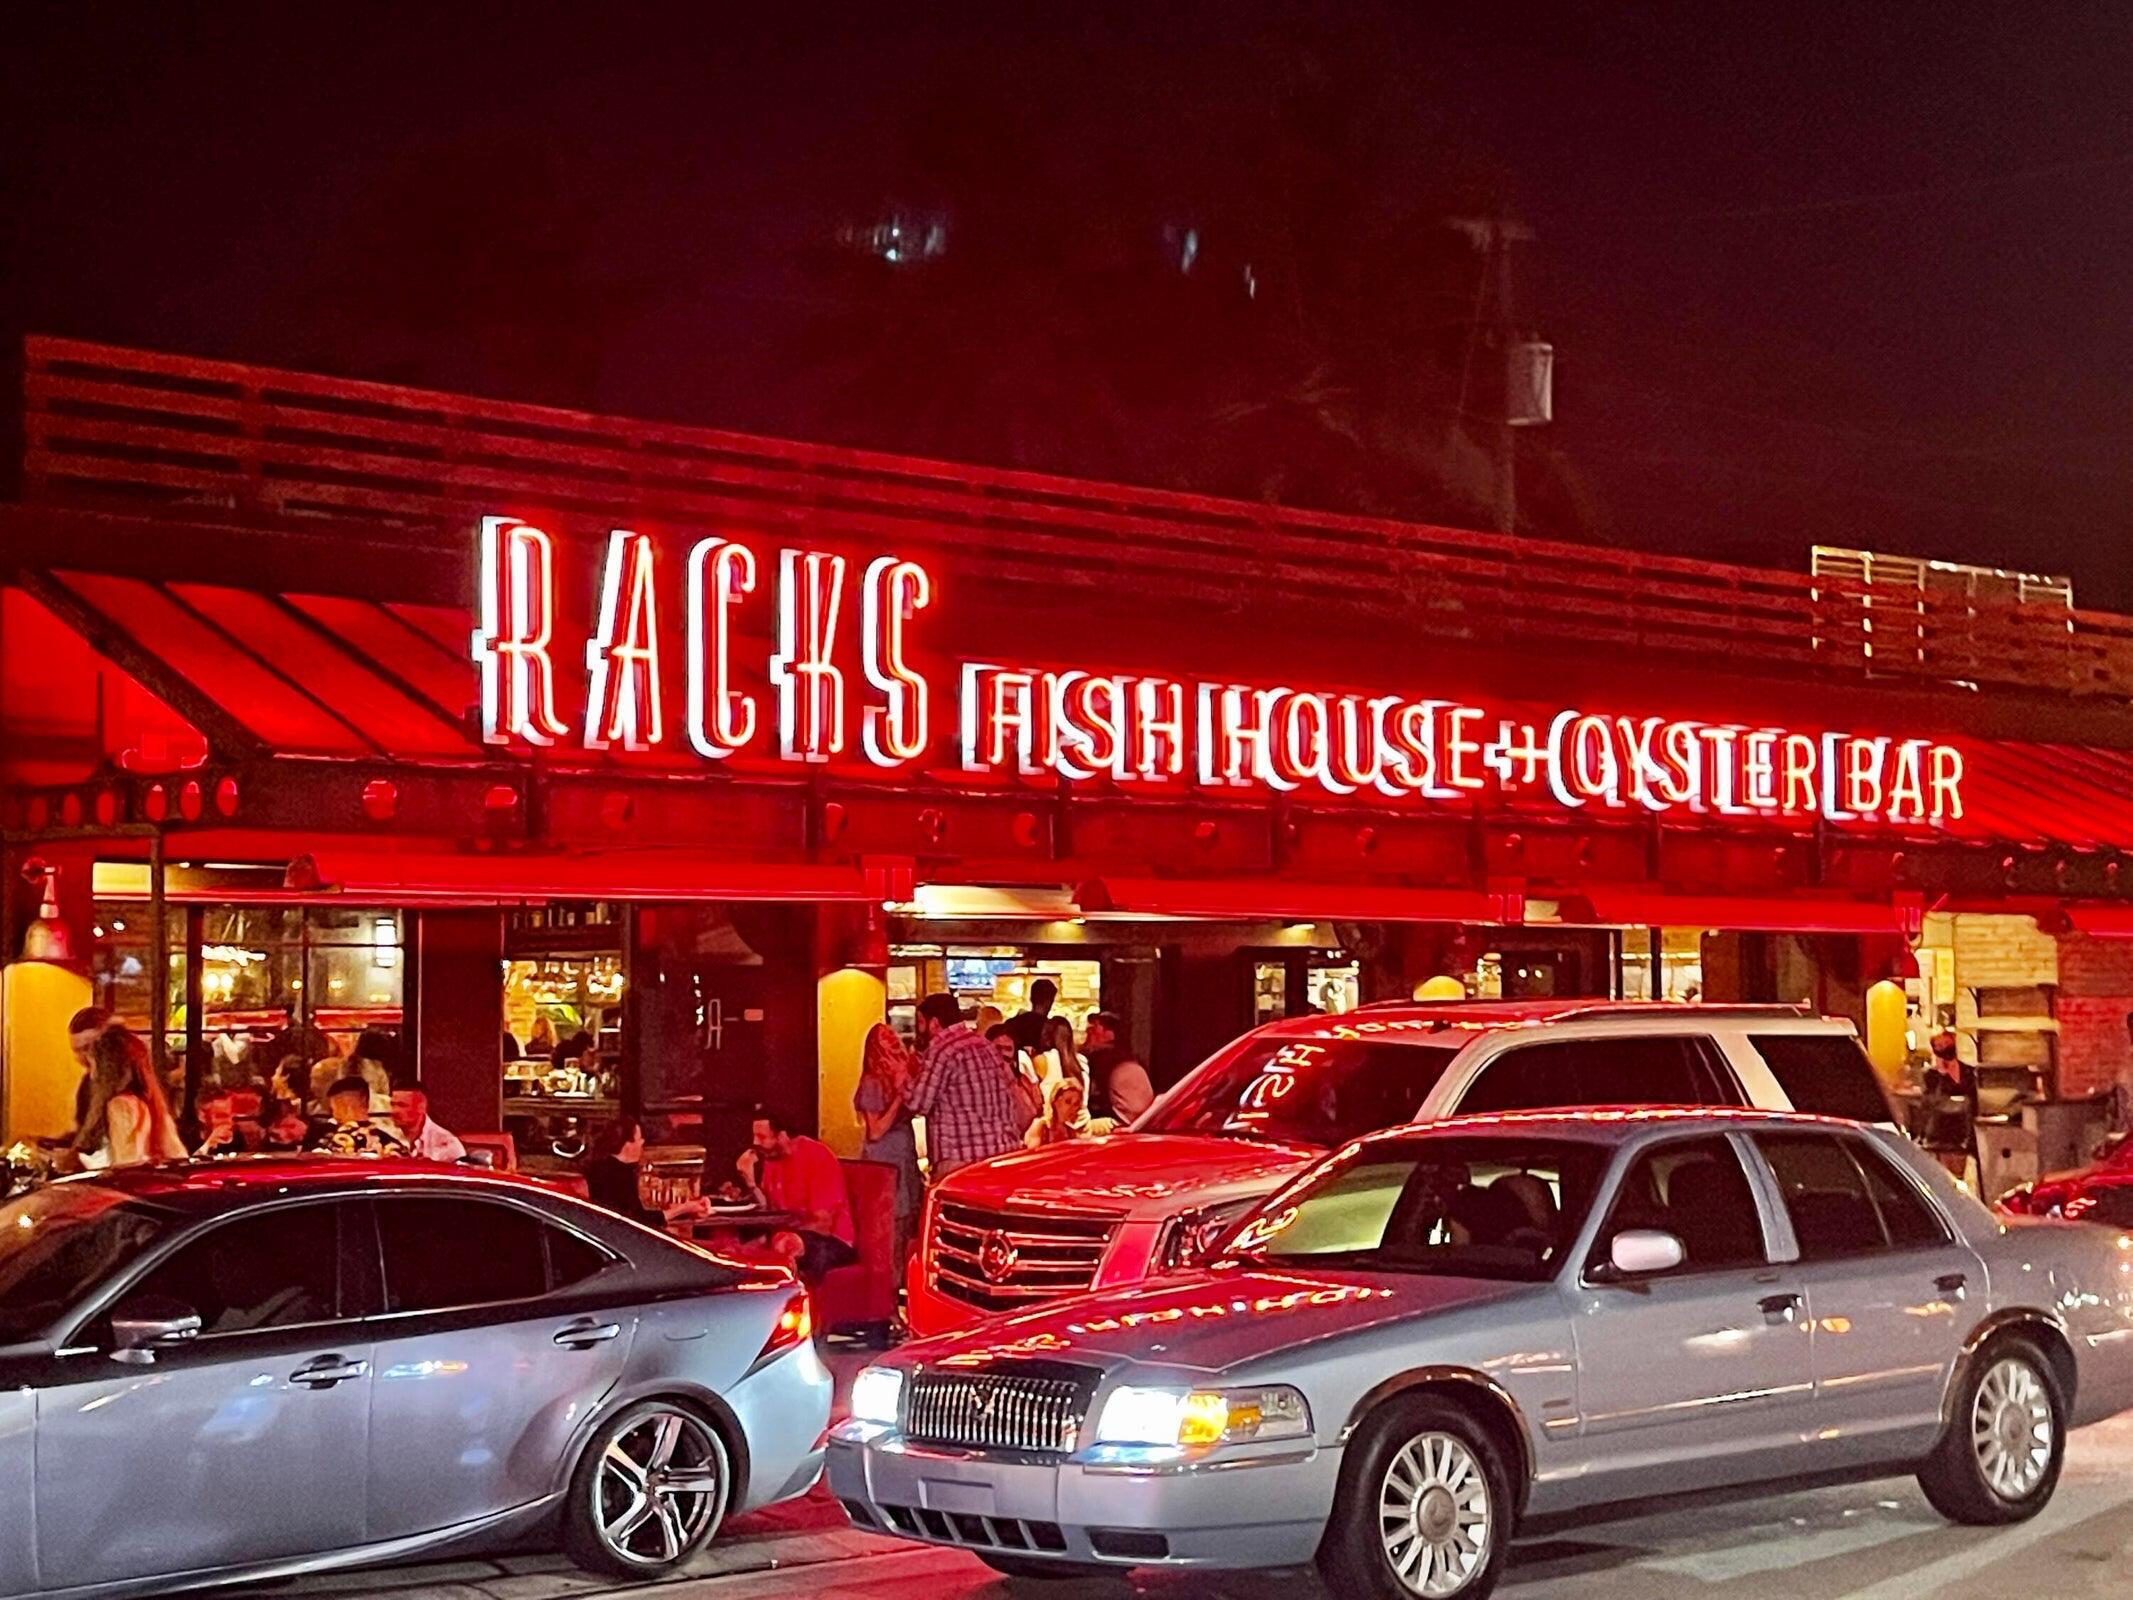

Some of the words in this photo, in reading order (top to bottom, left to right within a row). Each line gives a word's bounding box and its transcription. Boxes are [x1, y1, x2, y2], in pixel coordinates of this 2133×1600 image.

[471, 515, 931, 769] RACKS
[960, 663, 1184, 780] FISH
[1197, 682, 1485, 799] HOUSE
[1548, 710, 1818, 816] OYSTER
[1822, 732, 1965, 827] BAR
